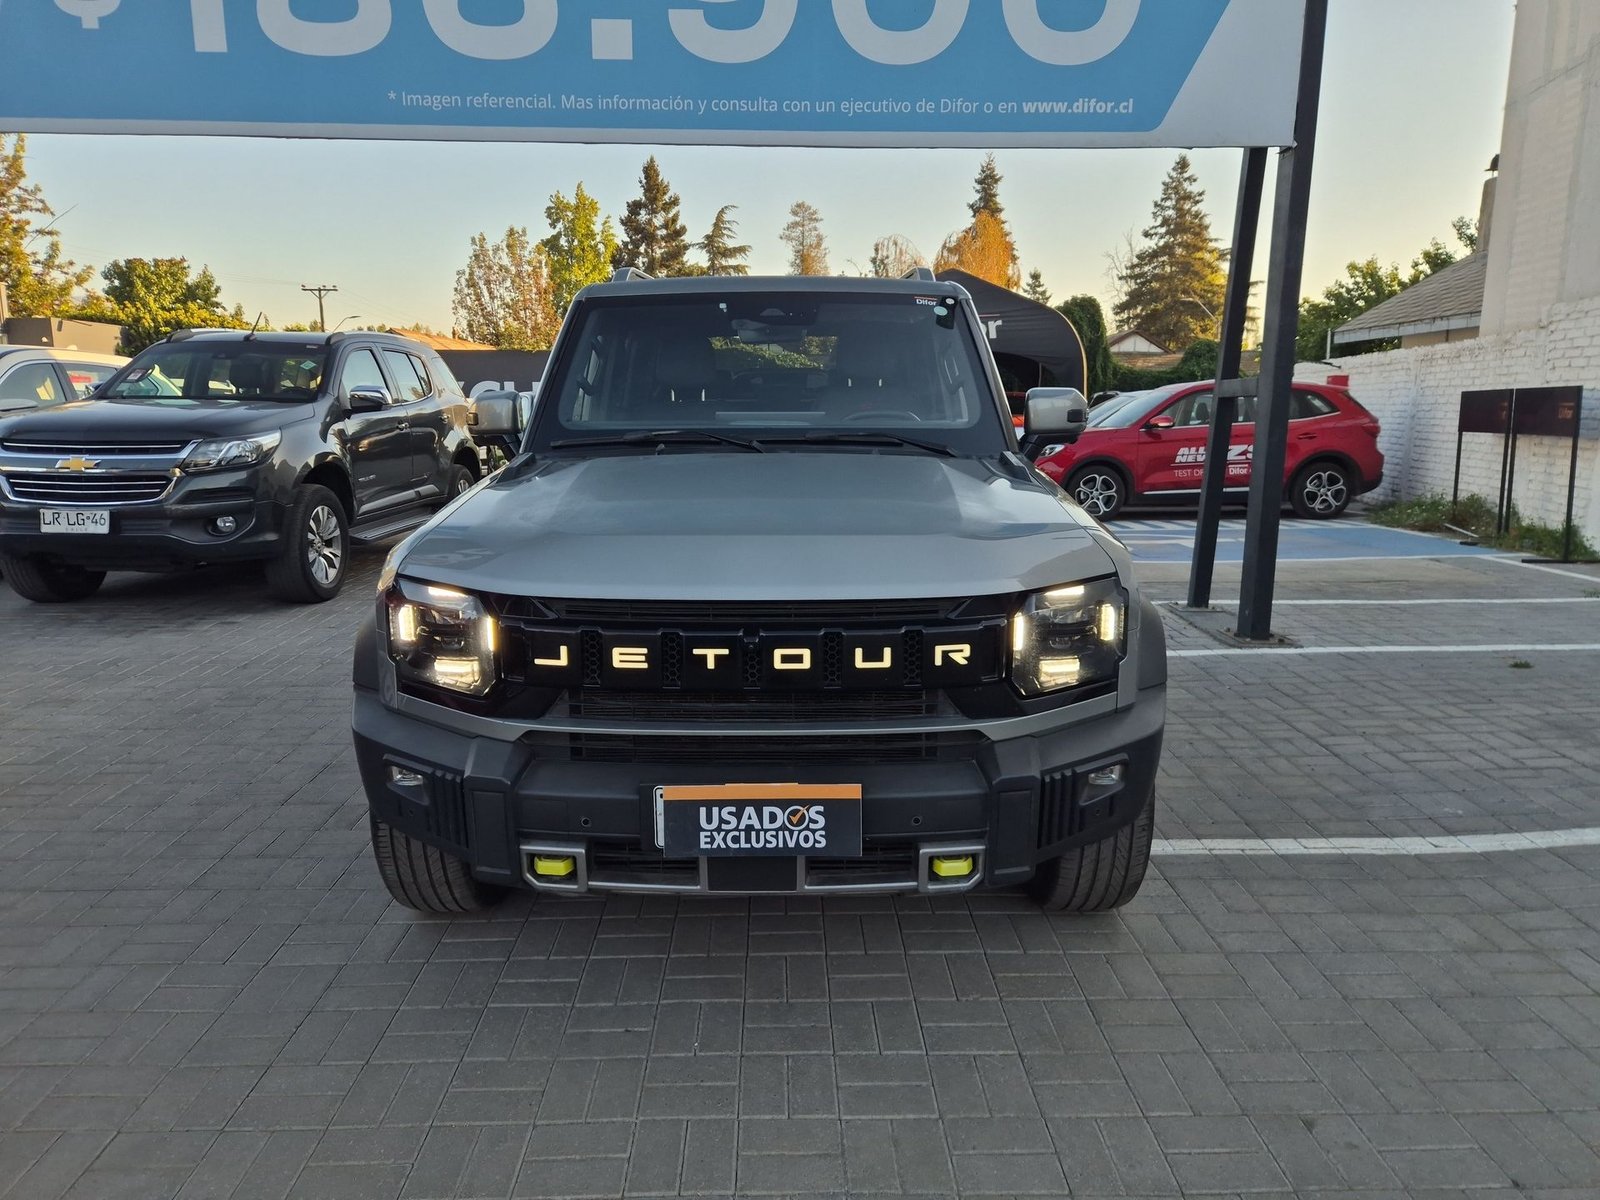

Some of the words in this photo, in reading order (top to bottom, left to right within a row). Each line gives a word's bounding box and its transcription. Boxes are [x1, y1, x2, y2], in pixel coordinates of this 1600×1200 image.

[402, 91, 461, 111] Imagen
[466, 92, 556, 109] referencial.
[561, 94, 593, 109] Mas
[598, 94, 693, 111] información
[698, 99, 706, 115] y
[711, 96, 778, 112] consulta
[782, 100, 811, 112] con
[815, 100, 836, 113] un
[840, 97, 911, 116] ejecutivo
[915, 98, 935, 113] de
[940, 98, 979, 113] Difor
[983, 101, 994, 113] o
[998, 101, 1017, 113] en
[1022, 97, 1134, 114] www.difor.cl
[916, 298, 937, 306] Difor
[1173, 468, 1191, 477] TEST
[533, 643, 971, 670] JETOUR
[699, 804, 826, 831] USADOS
[699, 830, 827, 849] EXCLUSIVOS
